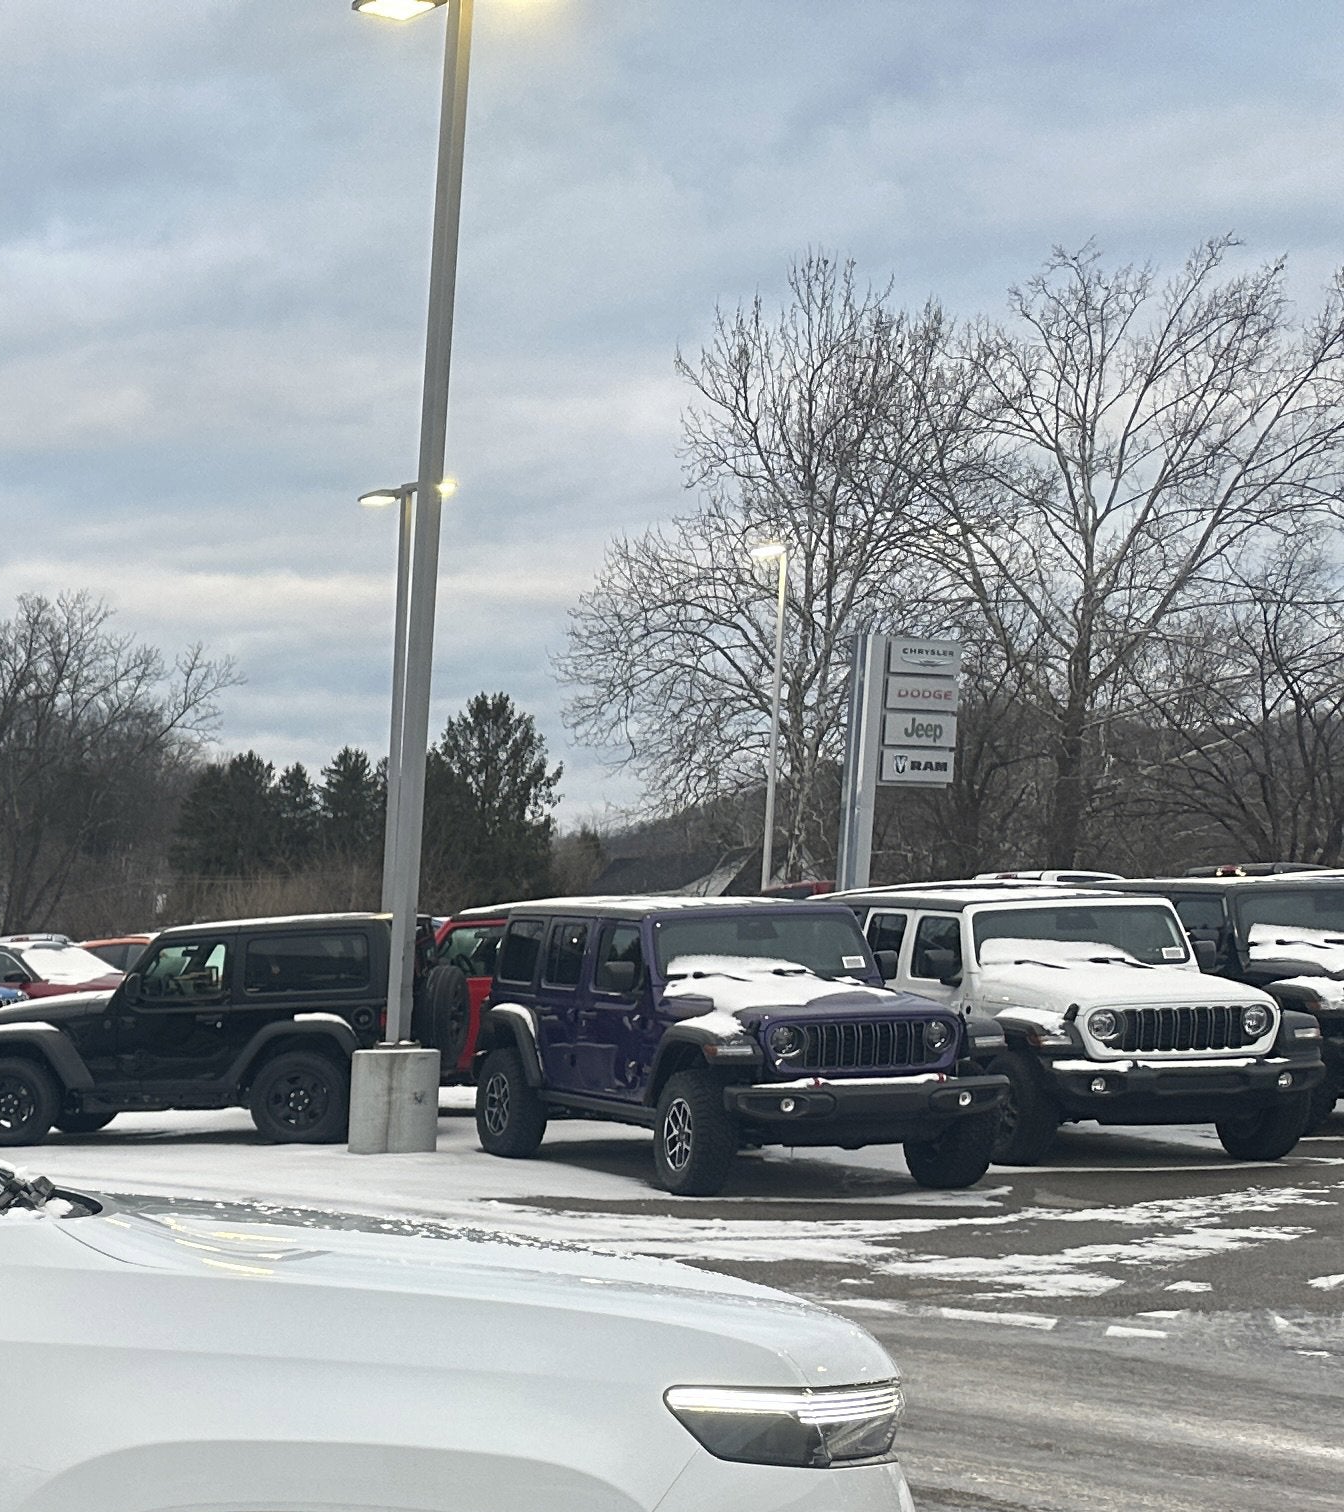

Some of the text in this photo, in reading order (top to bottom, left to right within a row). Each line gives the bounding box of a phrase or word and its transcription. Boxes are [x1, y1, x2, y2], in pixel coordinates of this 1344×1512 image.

[902, 647, 954, 657] CHRYSLER
[897, 690, 953, 701] DODGE
[904, 718, 943, 742] Jeep
[911, 761, 948, 772] RAM
